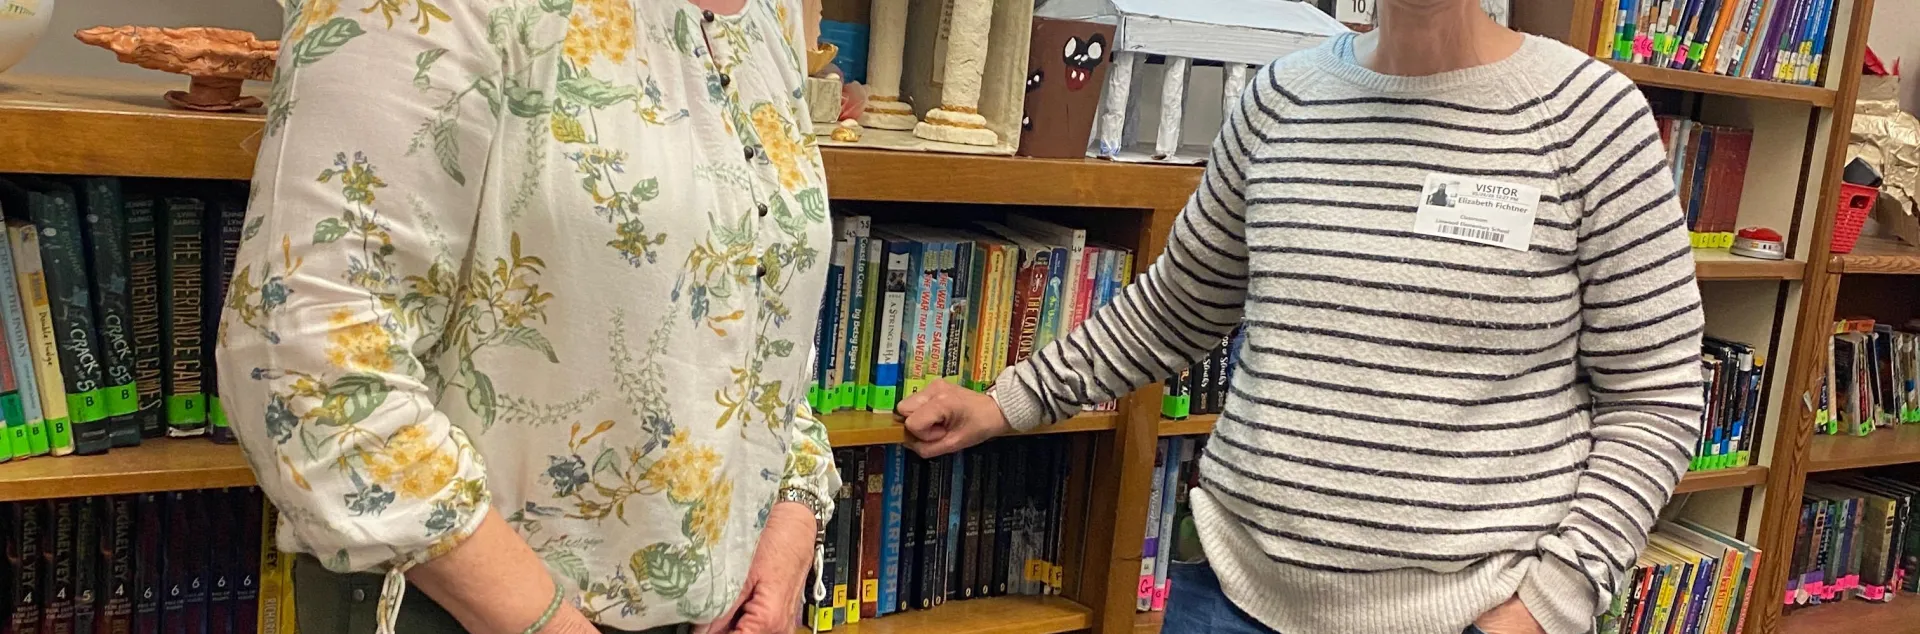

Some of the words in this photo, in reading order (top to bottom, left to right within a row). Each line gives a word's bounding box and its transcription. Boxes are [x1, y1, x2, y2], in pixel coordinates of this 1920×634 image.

[1475, 183, 1518, 197] VISITOR
[1458, 197, 1494, 208] Elizabeth
[1495, 201, 1528, 214] Fichtner
[1460, 222, 1489, 231] Elementary
[1491, 226, 1510, 234] School
[129, 227, 156, 258] THE
[172, 231, 202, 260] THE
[860, 236, 869, 262] Coast
[858, 263, 866, 272] to
[855, 274, 865, 297] Coast
[923, 273, 933, 287] THE
[938, 272, 948, 286] THE
[131, 261, 160, 354] INHERITANCE
[920, 291, 931, 311] WAR
[936, 289, 947, 309] WAR
[1028, 295, 1042, 313] THE
[172, 264, 202, 355] INHERITANCE
[852, 308, 862, 321] by
[38, 311, 50, 339] Double
[887, 307, 897, 342] STRING
[918, 313, 929, 331] THAT
[935, 311, 945, 329] THAT
[12, 316, 28, 358] INDIAN
[103, 314, 131, 360] CRACK
[850, 321, 861, 345] Betsy
[946, 323, 955, 354] FINALLY
[1017, 316, 1038, 361] CANYON'S
[43, 342, 54, 367] Fudge
[69, 328, 98, 374] CRACK
[914, 333, 926, 362] SAVED
[930, 331, 942, 360] SAVED
[848, 345, 859, 370] Byars
[883, 349, 894, 362] HA
[951, 346, 960, 366] WAR
[914, 362, 923, 375] MY
[930, 360, 939, 373] MY
[945, 355, 954, 376] WO
[109, 365, 132, 386] SE
[135, 357, 163, 411] GAMES
[172, 359, 202, 396] GAM
[85, 396, 94, 406] B
[121, 389, 130, 399] B
[184, 399, 194, 410] B
[16, 429, 23, 437] B
[32, 427, 39, 435] B
[55, 423, 64, 433] B
[23, 504, 38, 560] MICHAEL
[56, 502, 71, 557] MICHAEL
[115, 500, 130, 555] MICHAEL
[886, 483, 902, 593] STARFISH
[22, 561, 37, 590] VEY
[56, 558, 71, 584] VEY
[114, 555, 130, 581] VEY
[1032, 564, 1041, 576] F
[114, 583, 125, 596] 4
[191, 576, 201, 589] 6
[216, 575, 226, 588] 6
[243, 574, 252, 587] 6
[1140, 579, 1153, 593] G
[23, 591, 33, 603] 4
[56, 586, 66, 599] 4
[82, 589, 92, 602] 5
[143, 586, 153, 599] 6
[170, 584, 180, 597] 6
[836, 591, 844, 603] F
[865, 584, 873, 597] F
[823, 611, 828, 619] F
[850, 602, 855, 611] F
